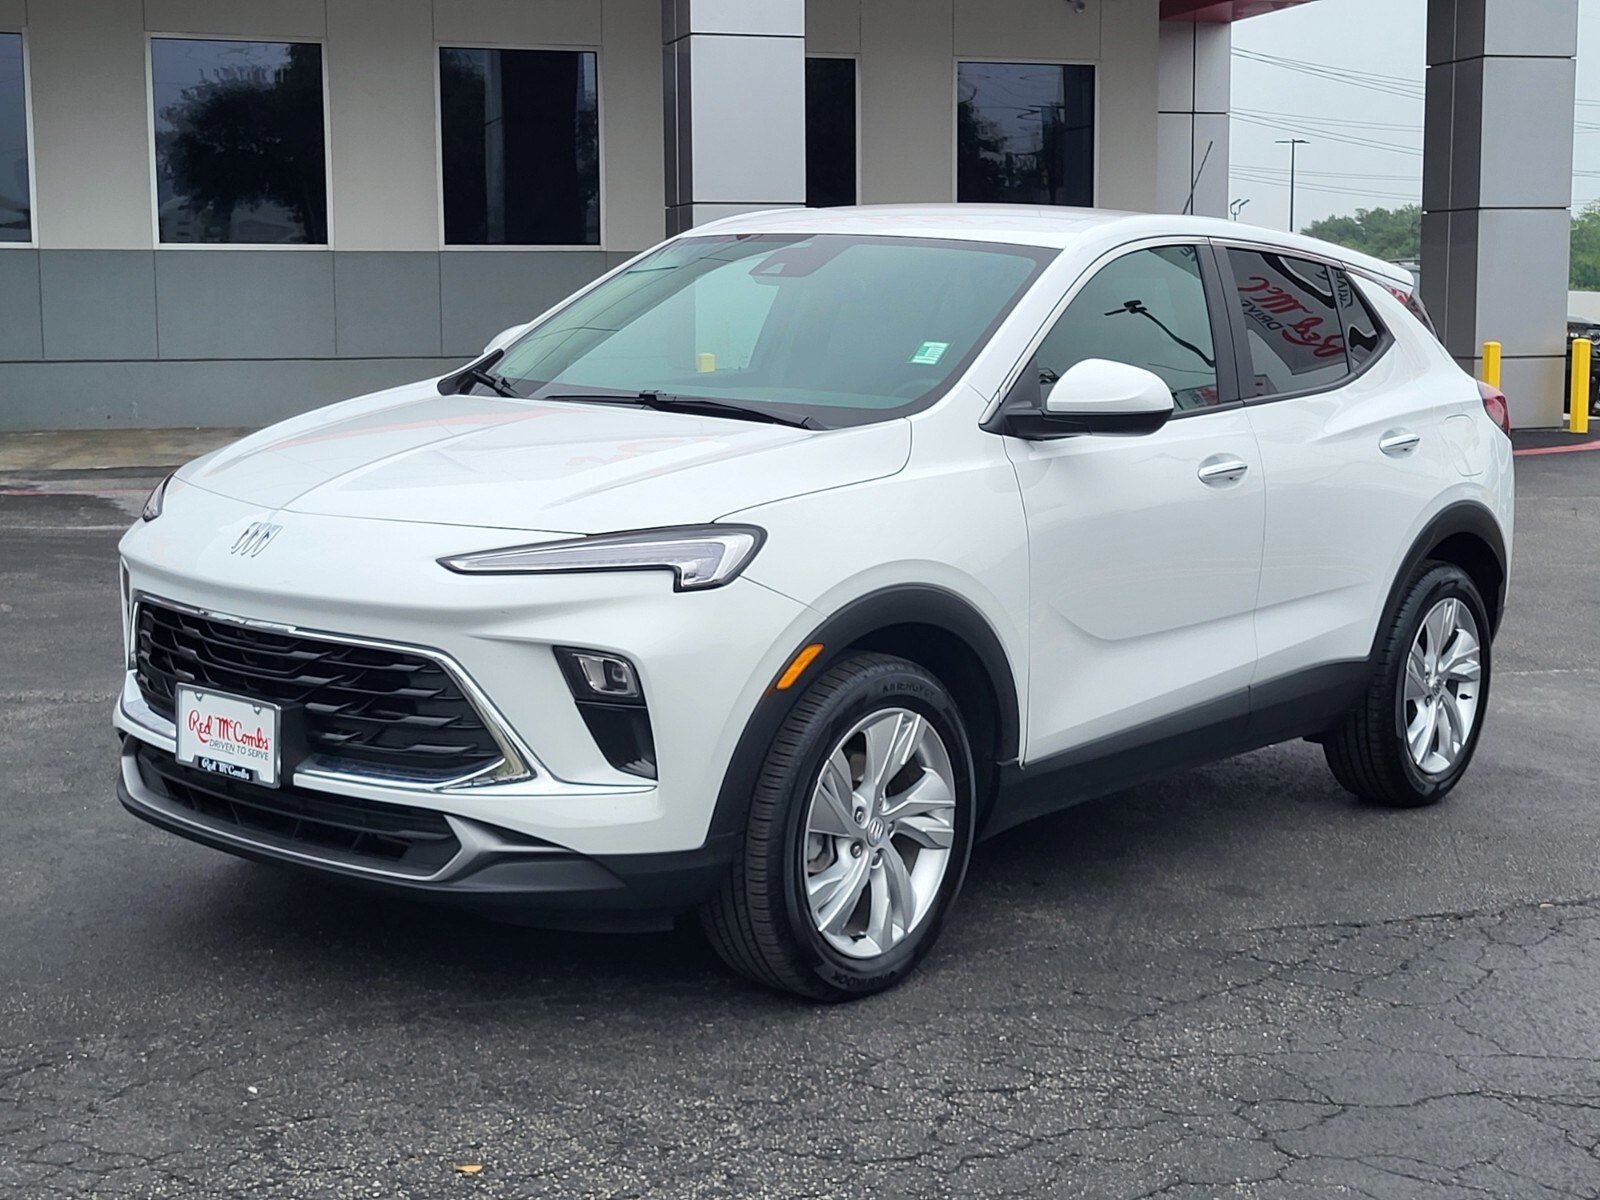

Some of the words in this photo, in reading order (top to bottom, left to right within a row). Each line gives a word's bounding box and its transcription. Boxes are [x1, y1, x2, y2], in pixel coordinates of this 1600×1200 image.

[188, 709, 213, 743] Red
[214, 715, 269, 751] McCombs
[208, 739, 235, 753] DRIVEN
[236, 745, 247, 756] TO
[247, 749, 269, 761] SERVE
[201, 758, 217, 772] Red
[218, 763, 250, 780] McCombs
